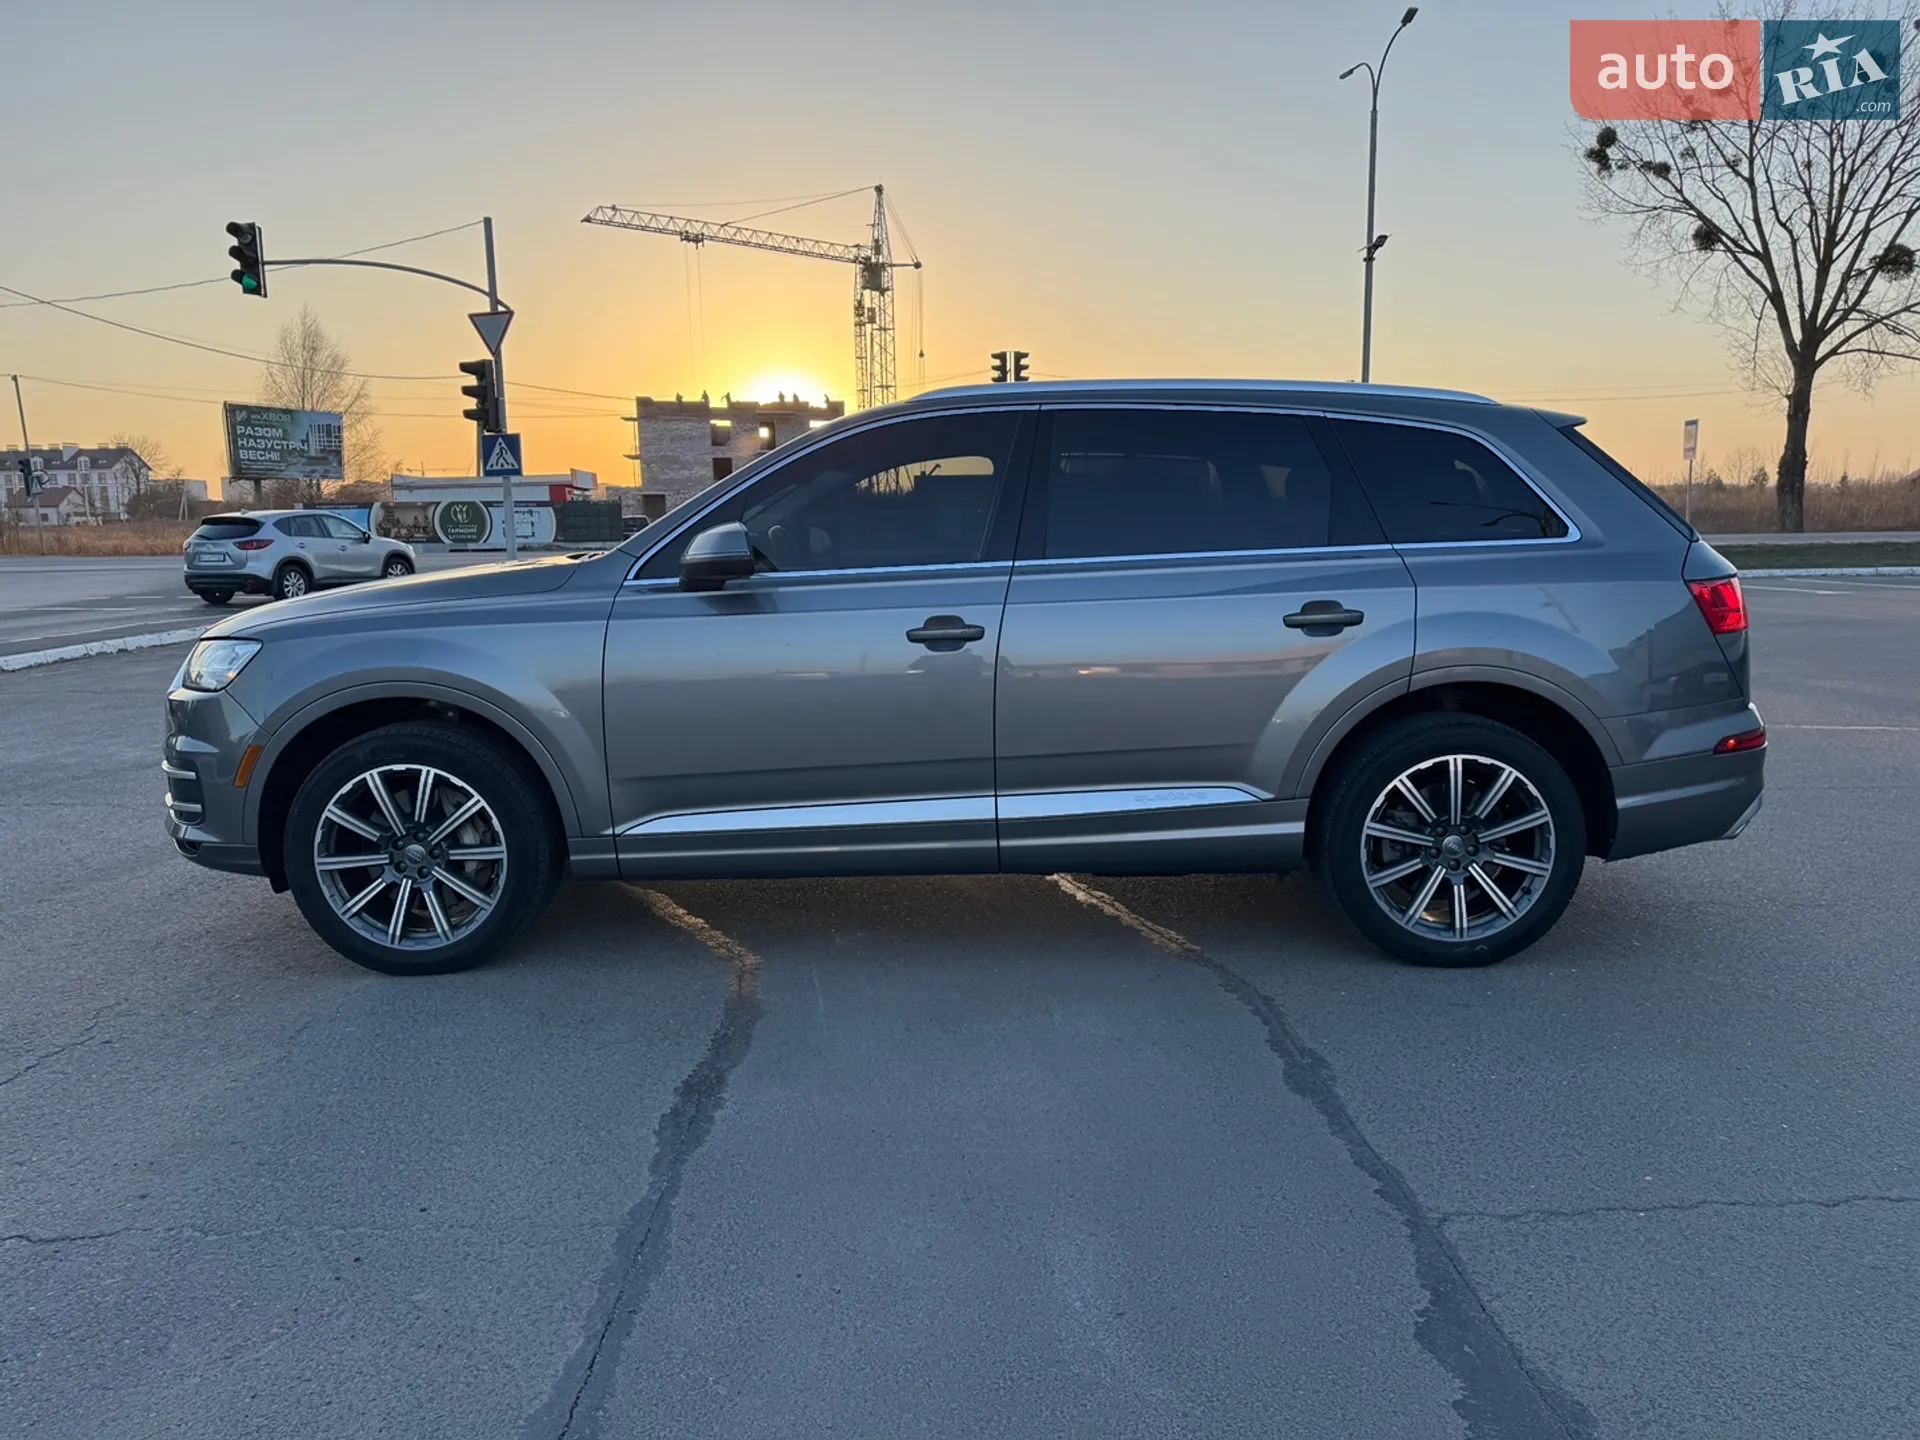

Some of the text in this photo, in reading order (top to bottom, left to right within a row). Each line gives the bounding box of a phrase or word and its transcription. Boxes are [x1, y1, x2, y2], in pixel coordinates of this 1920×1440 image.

[261, 411, 291, 422] ХВОЯ
[236, 425, 283, 438] РАЗОМ
[238, 437, 308, 451] НАЗУСТРІЧ
[239, 449, 280, 461] ВЕСНІ!
